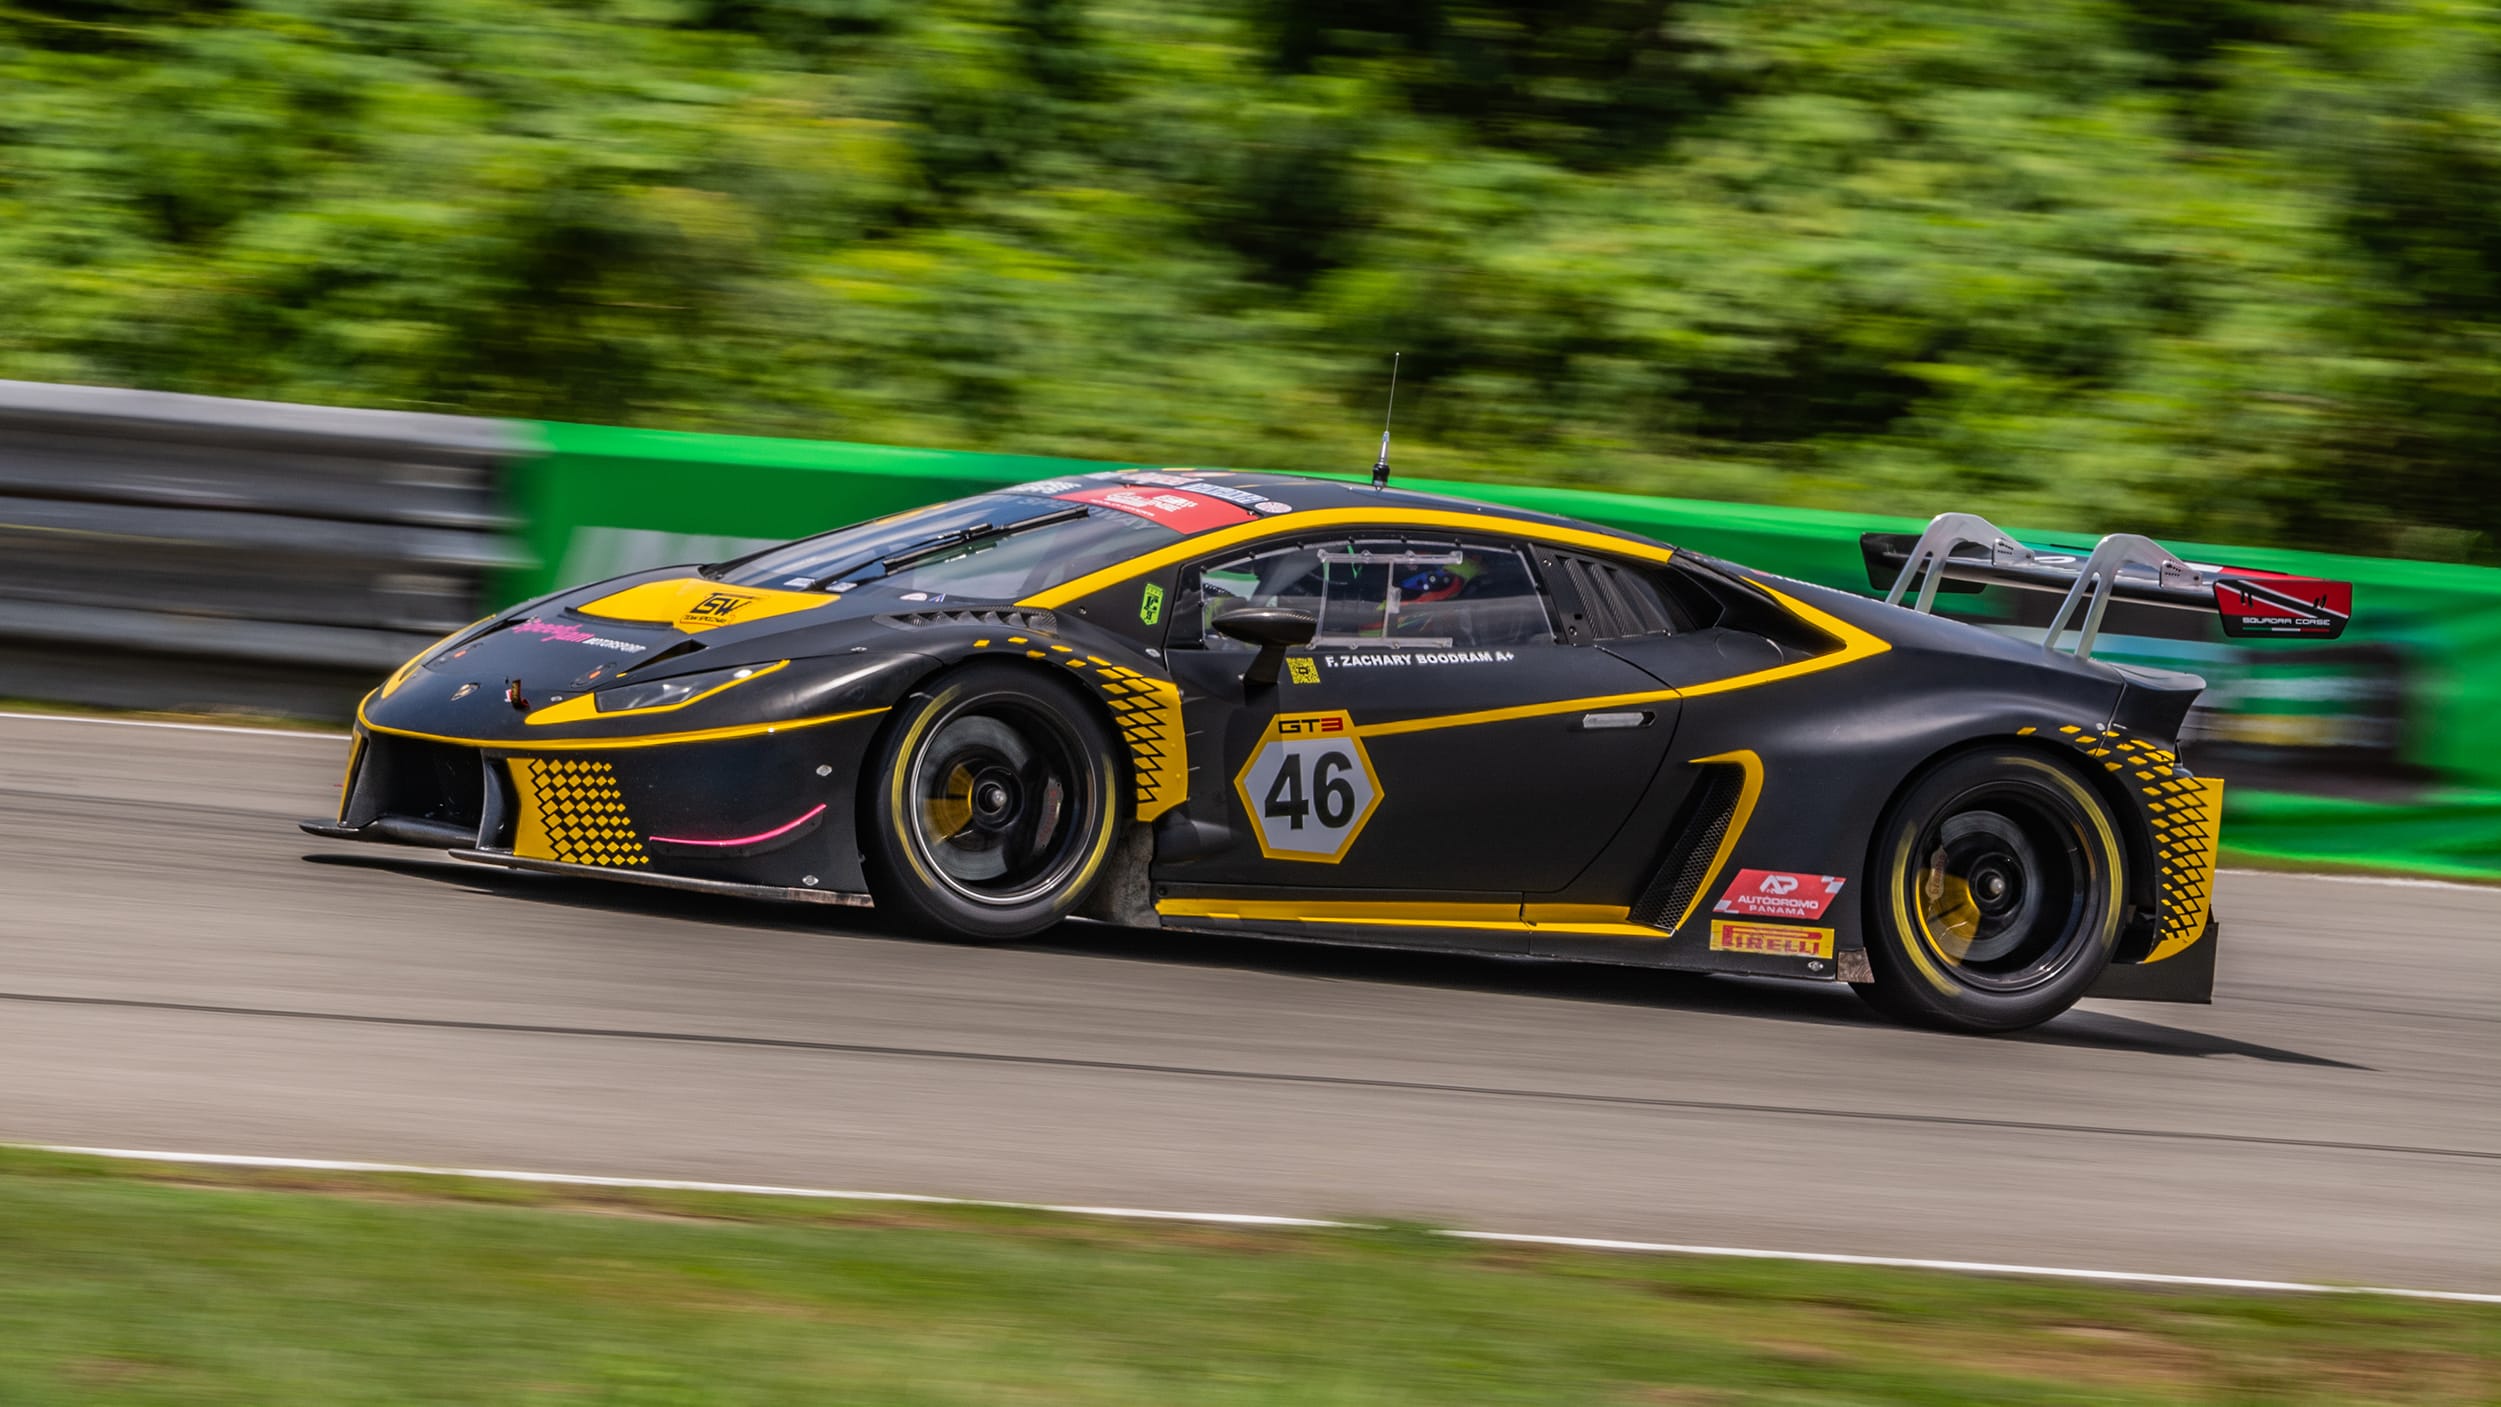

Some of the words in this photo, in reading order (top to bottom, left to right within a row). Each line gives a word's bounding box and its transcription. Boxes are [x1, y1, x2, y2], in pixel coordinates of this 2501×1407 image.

[2295, 618, 2331, 626] CORSE
[1325, 656, 1339, 668] F.
[1342, 654, 1412, 667] ZACHARY
[1415, 652, 1493, 665] BOODRAM
[1495, 651, 1515, 662] A+
[1278, 717, 1344, 734] GT3
[1264, 750, 1356, 831] 46
[1722, 925, 1823, 955] PIRELLI
